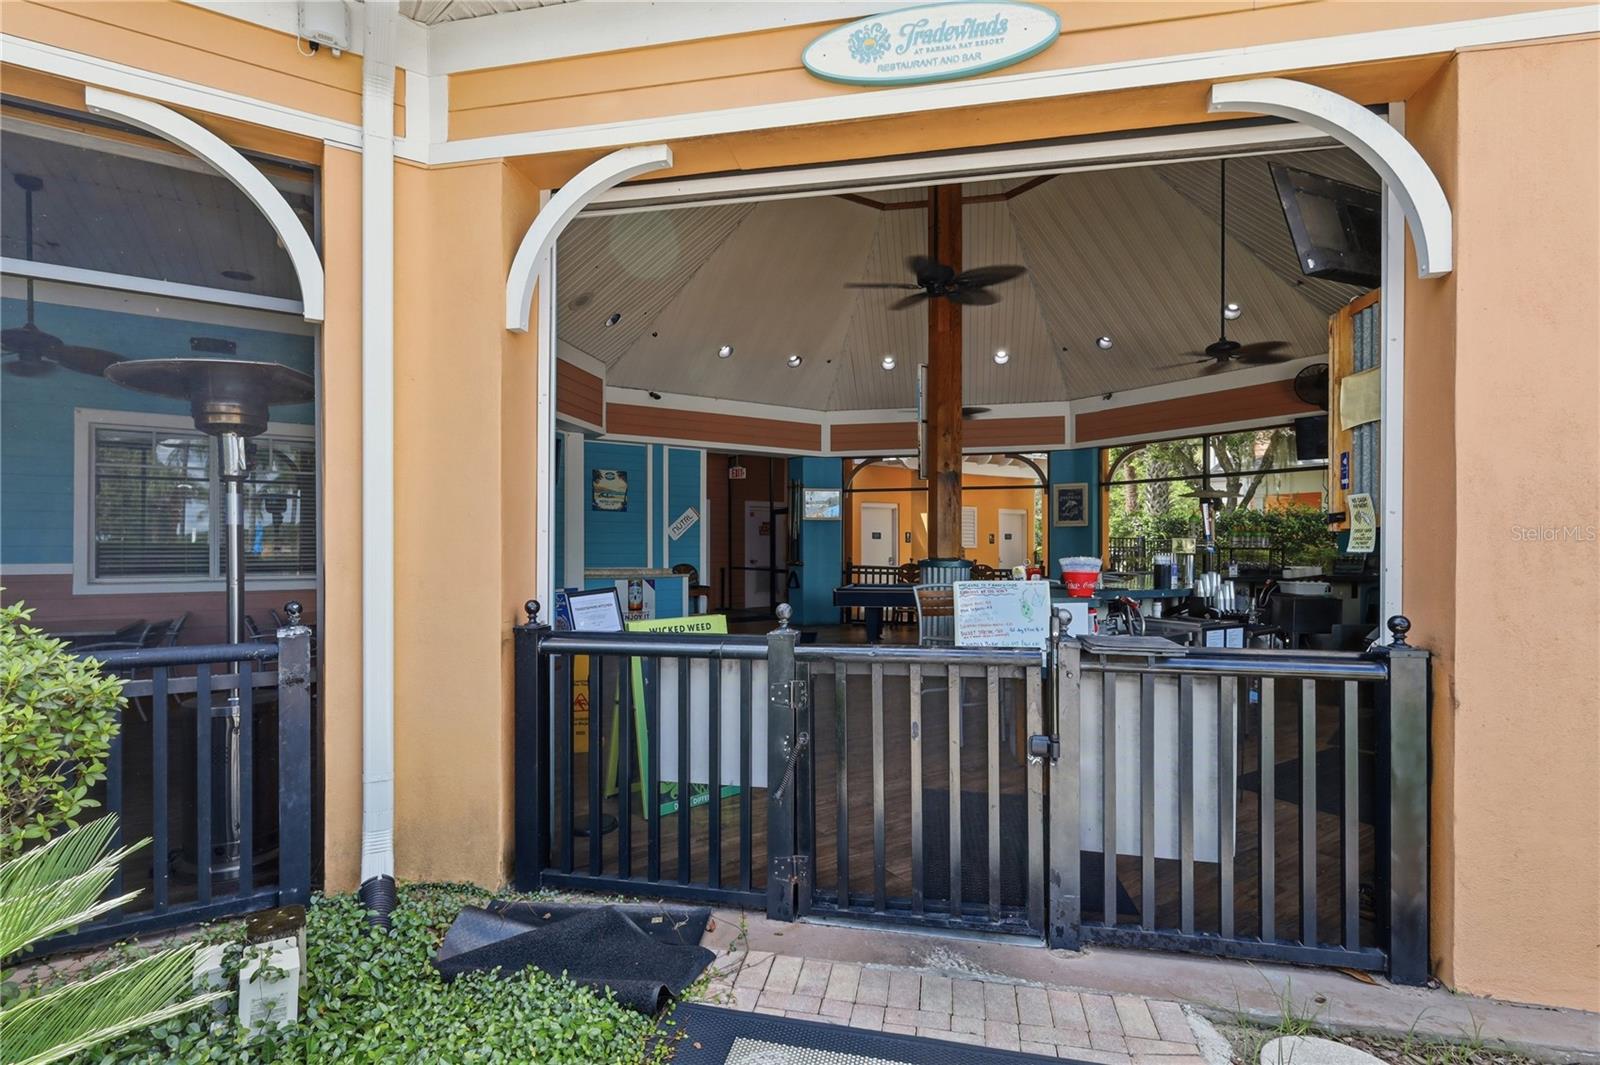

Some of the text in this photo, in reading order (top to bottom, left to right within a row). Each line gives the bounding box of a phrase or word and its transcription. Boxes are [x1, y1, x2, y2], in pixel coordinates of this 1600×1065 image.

[896, 13, 1008, 55] Tradewinds
[914, 47, 923, 55] AT
[877, 52, 982, 72] RESTAURANT AND BAR
[687, 622, 712, 631] WEED
